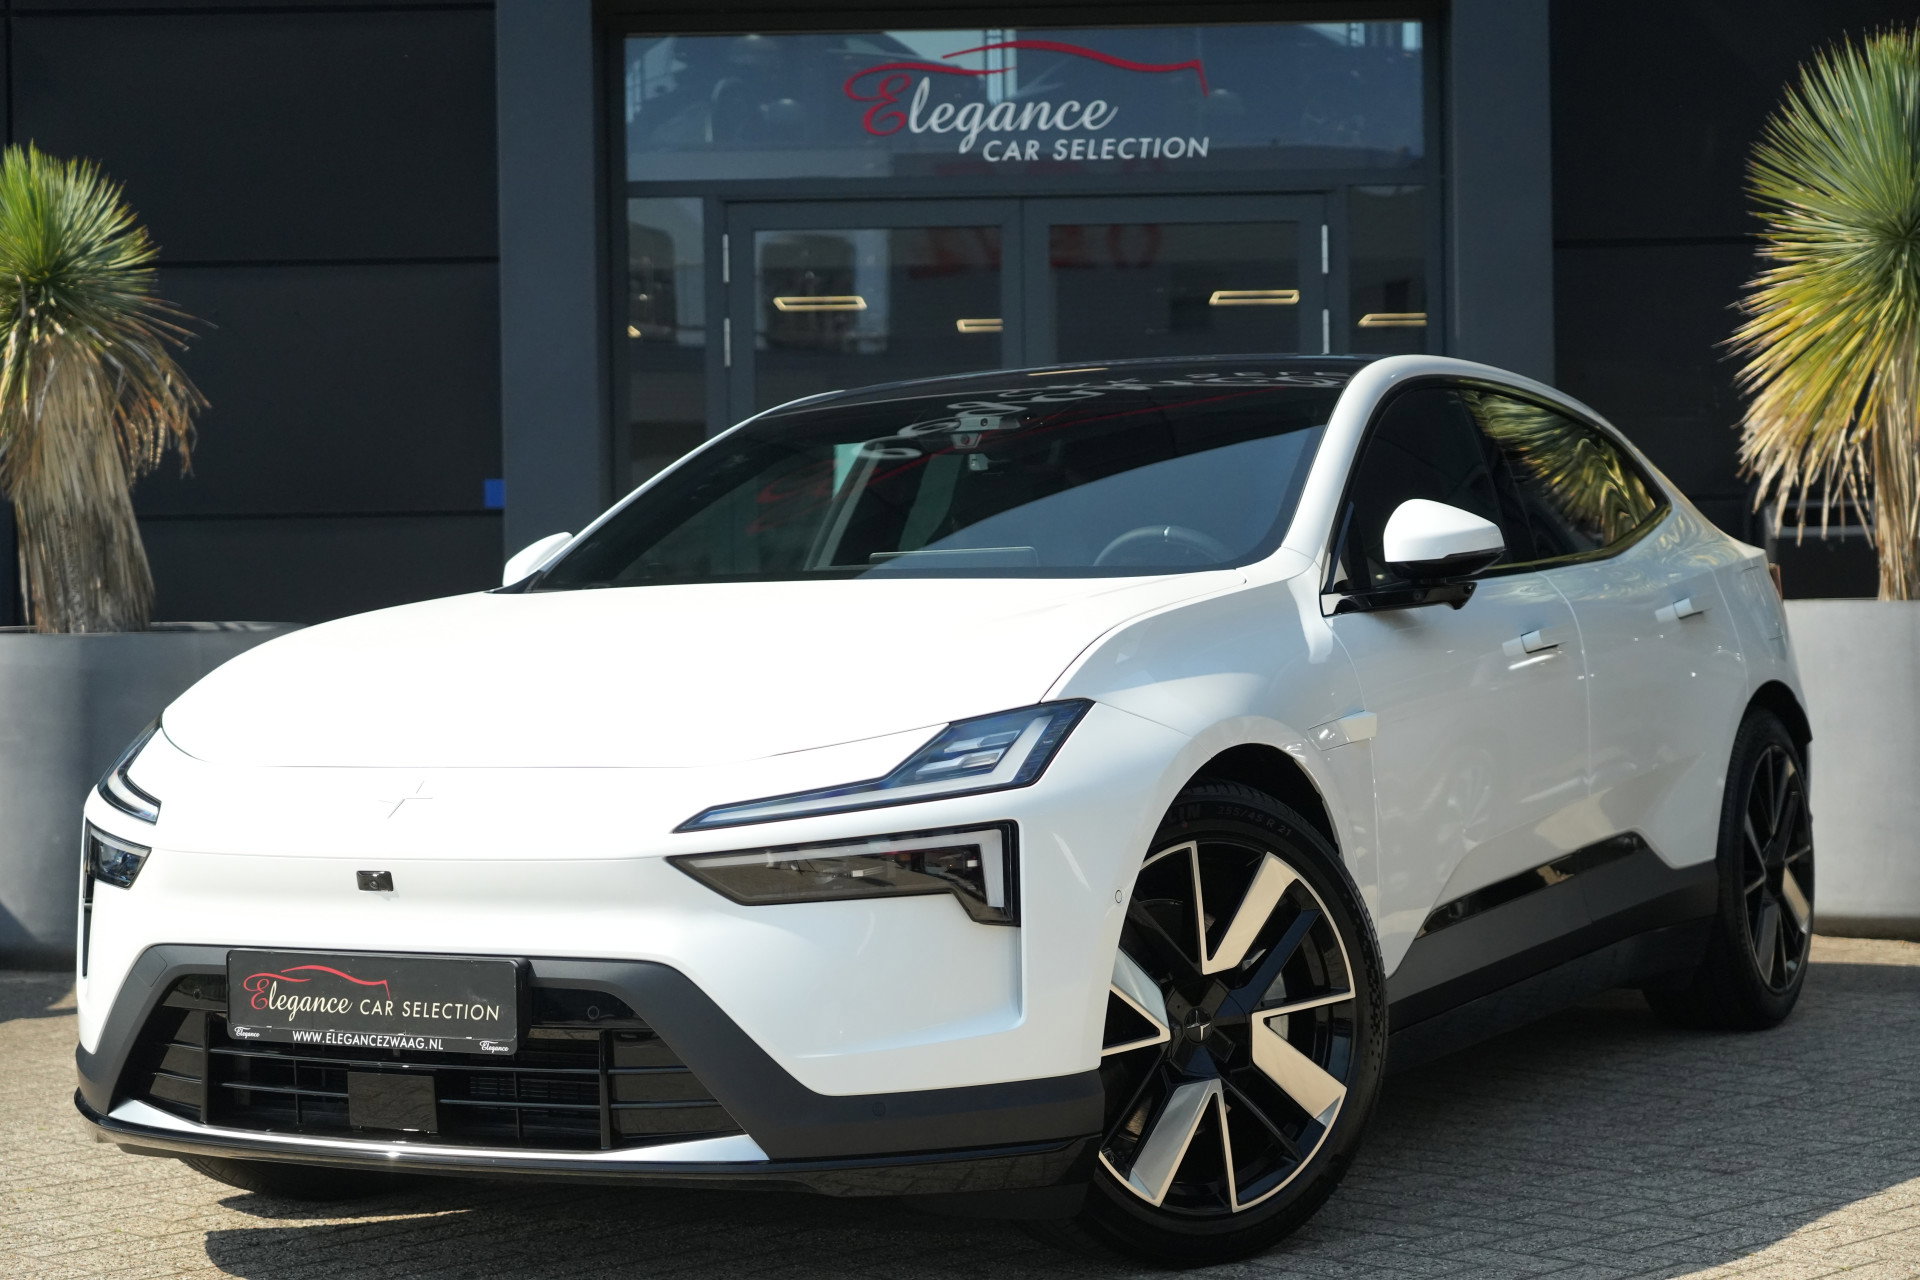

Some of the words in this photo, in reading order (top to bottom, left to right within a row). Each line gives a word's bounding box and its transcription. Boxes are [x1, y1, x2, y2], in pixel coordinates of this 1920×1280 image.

[844, 68, 1119, 154] Elegance
[982, 139, 1041, 162] CAR
[1052, 136, 1210, 162] SELECTION
[244, 976, 353, 1022] Elegance
[359, 999, 394, 1017] CAR
[402, 1001, 500, 1022] SELECTION
[292, 1030, 444, 1051] WWW.ELEGANCEZWAAG.NL
